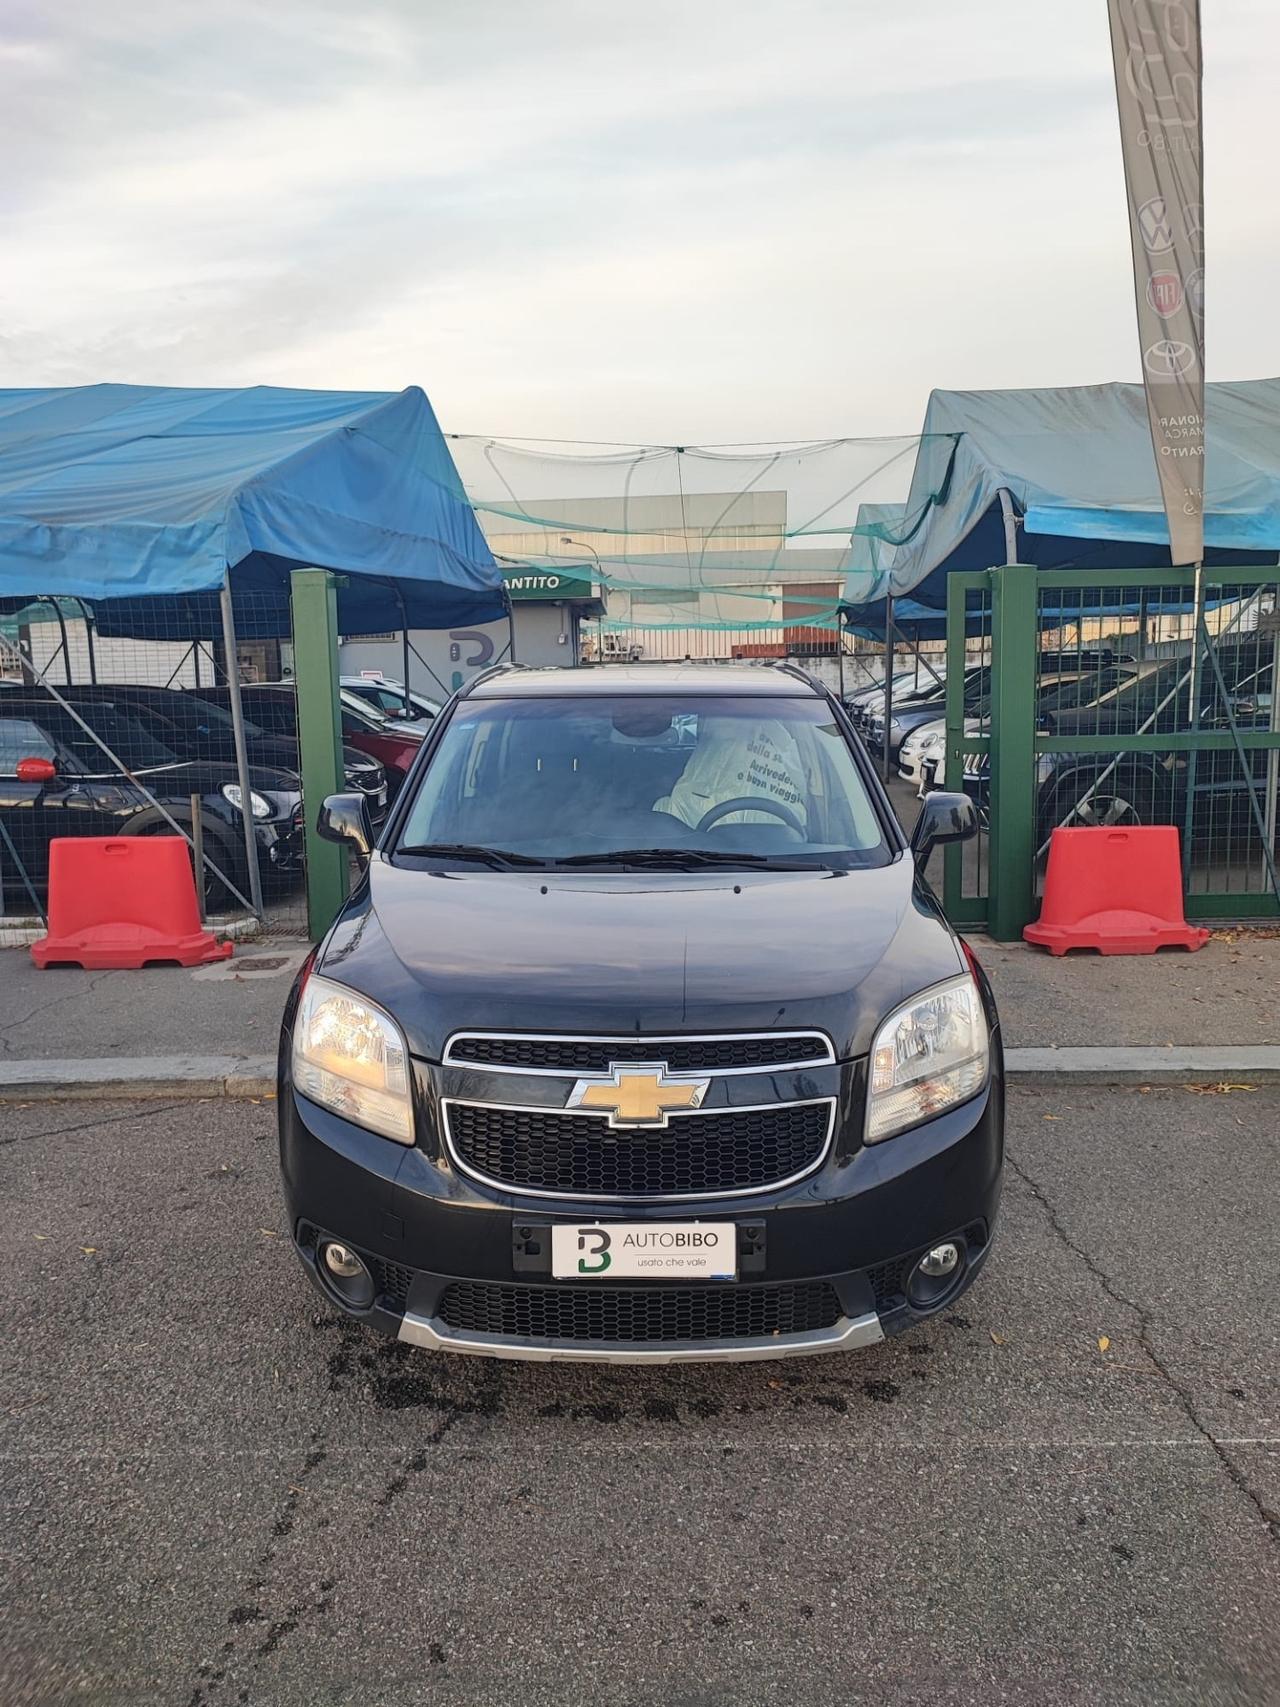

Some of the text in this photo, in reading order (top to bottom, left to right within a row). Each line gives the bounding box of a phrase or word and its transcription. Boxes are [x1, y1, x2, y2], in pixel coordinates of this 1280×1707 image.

[747, 740, 770, 758] della
[622, 1232, 718, 1248] AUTOBIBO
[637, 1256, 707, 1267] usato che vale
